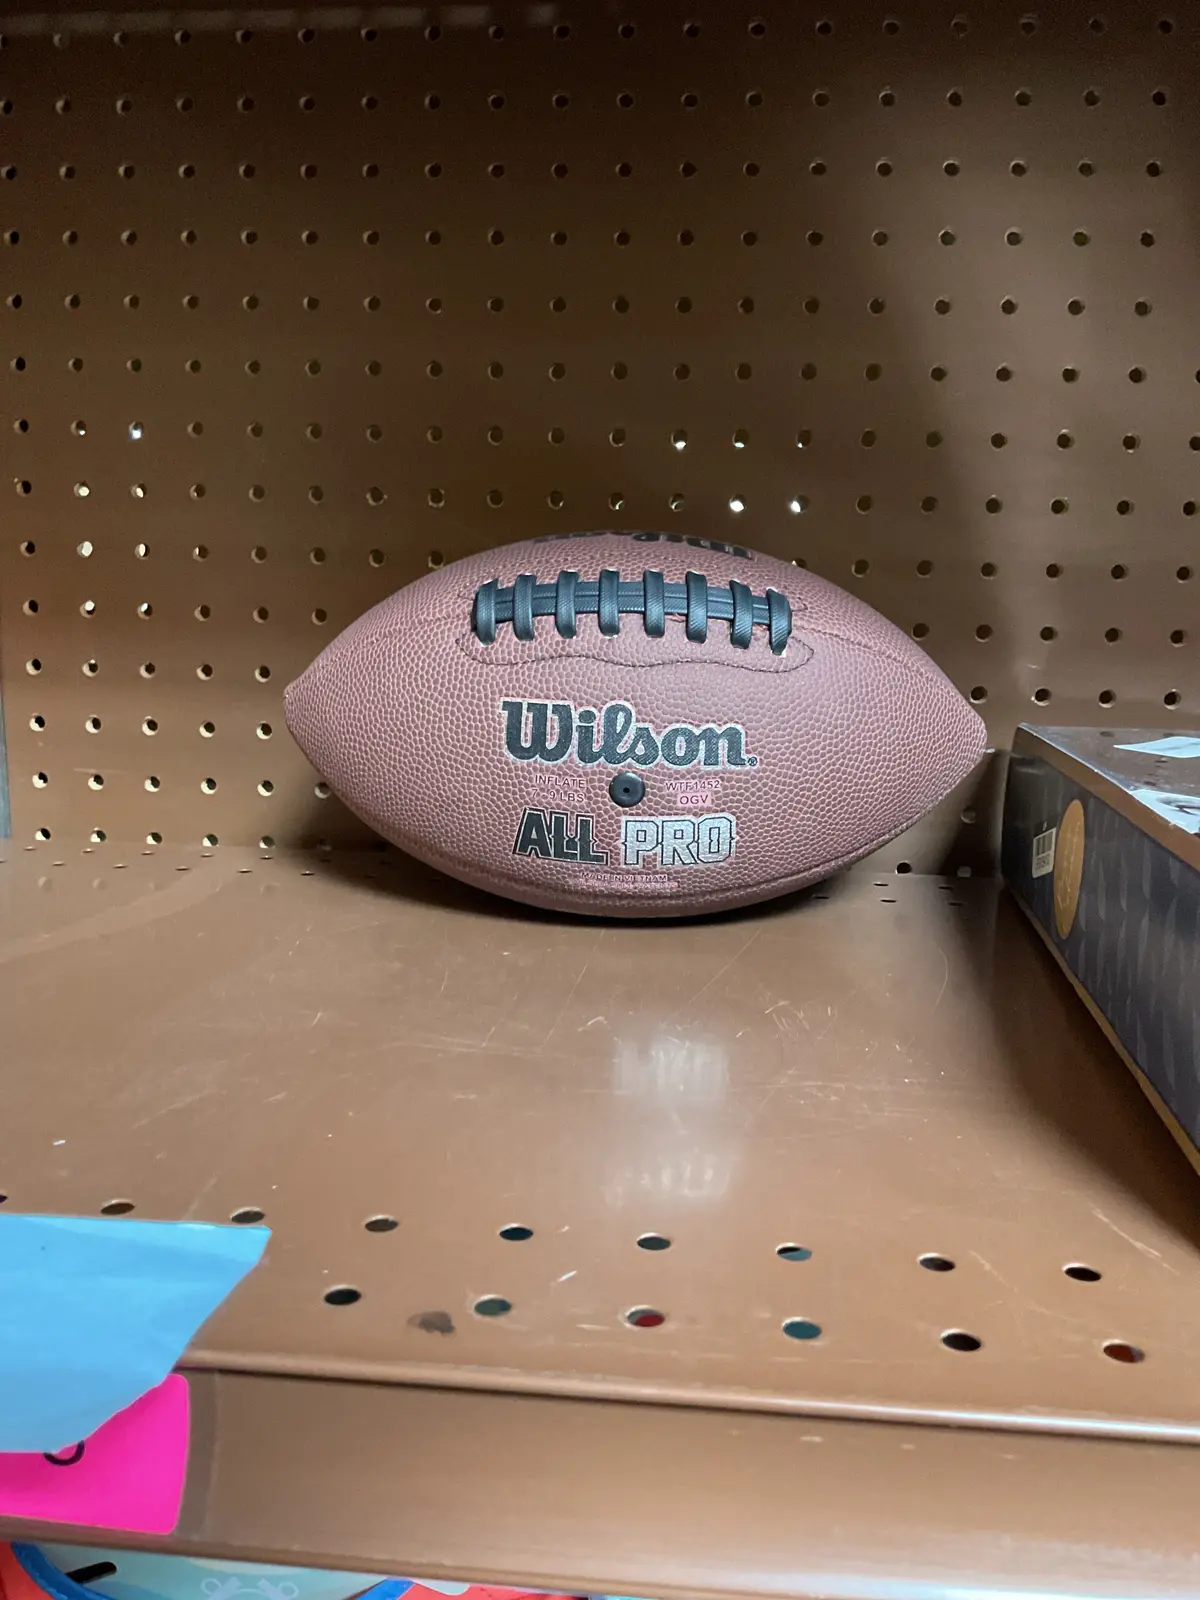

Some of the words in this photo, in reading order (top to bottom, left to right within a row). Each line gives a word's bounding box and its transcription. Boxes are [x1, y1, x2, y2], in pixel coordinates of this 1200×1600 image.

[535, 774, 586, 789] INFLATE
[665, 779, 721, 792] WTF1452
[531, 788, 538, 798] 7
[549, 790, 556, 800] 9
[560, 791, 585, 803] LBS
[679, 794, 709, 805] OGV
[513, 807, 609, 866] ALL
[621, 813, 737, 867] PRO
